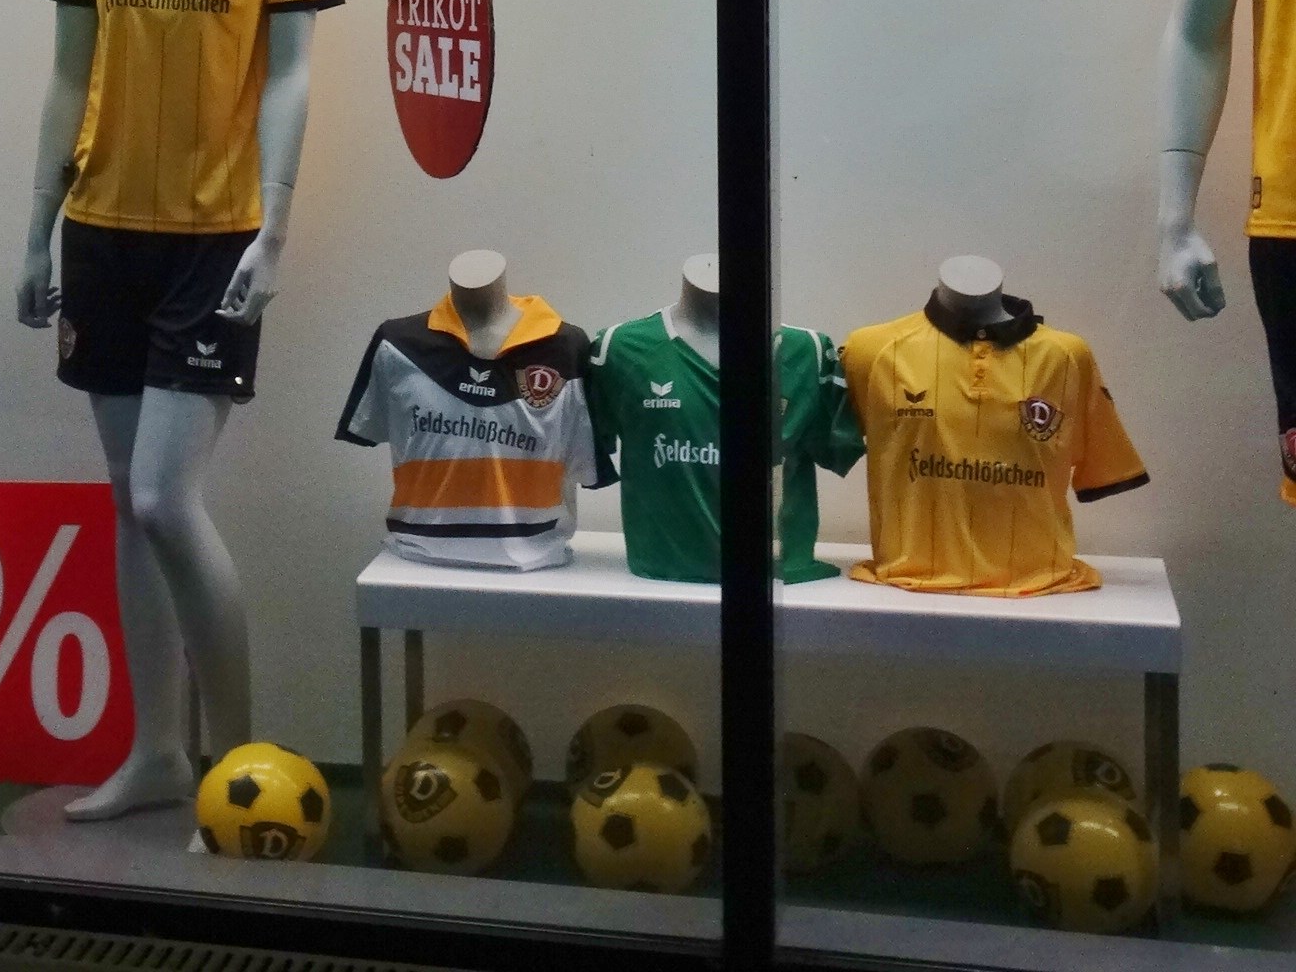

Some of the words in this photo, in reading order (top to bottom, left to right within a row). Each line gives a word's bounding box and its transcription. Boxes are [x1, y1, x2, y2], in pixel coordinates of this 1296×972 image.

[395, 31, 481, 102] SALE
[458, 382, 497, 398] erima
[643, 397, 682, 409] erima
